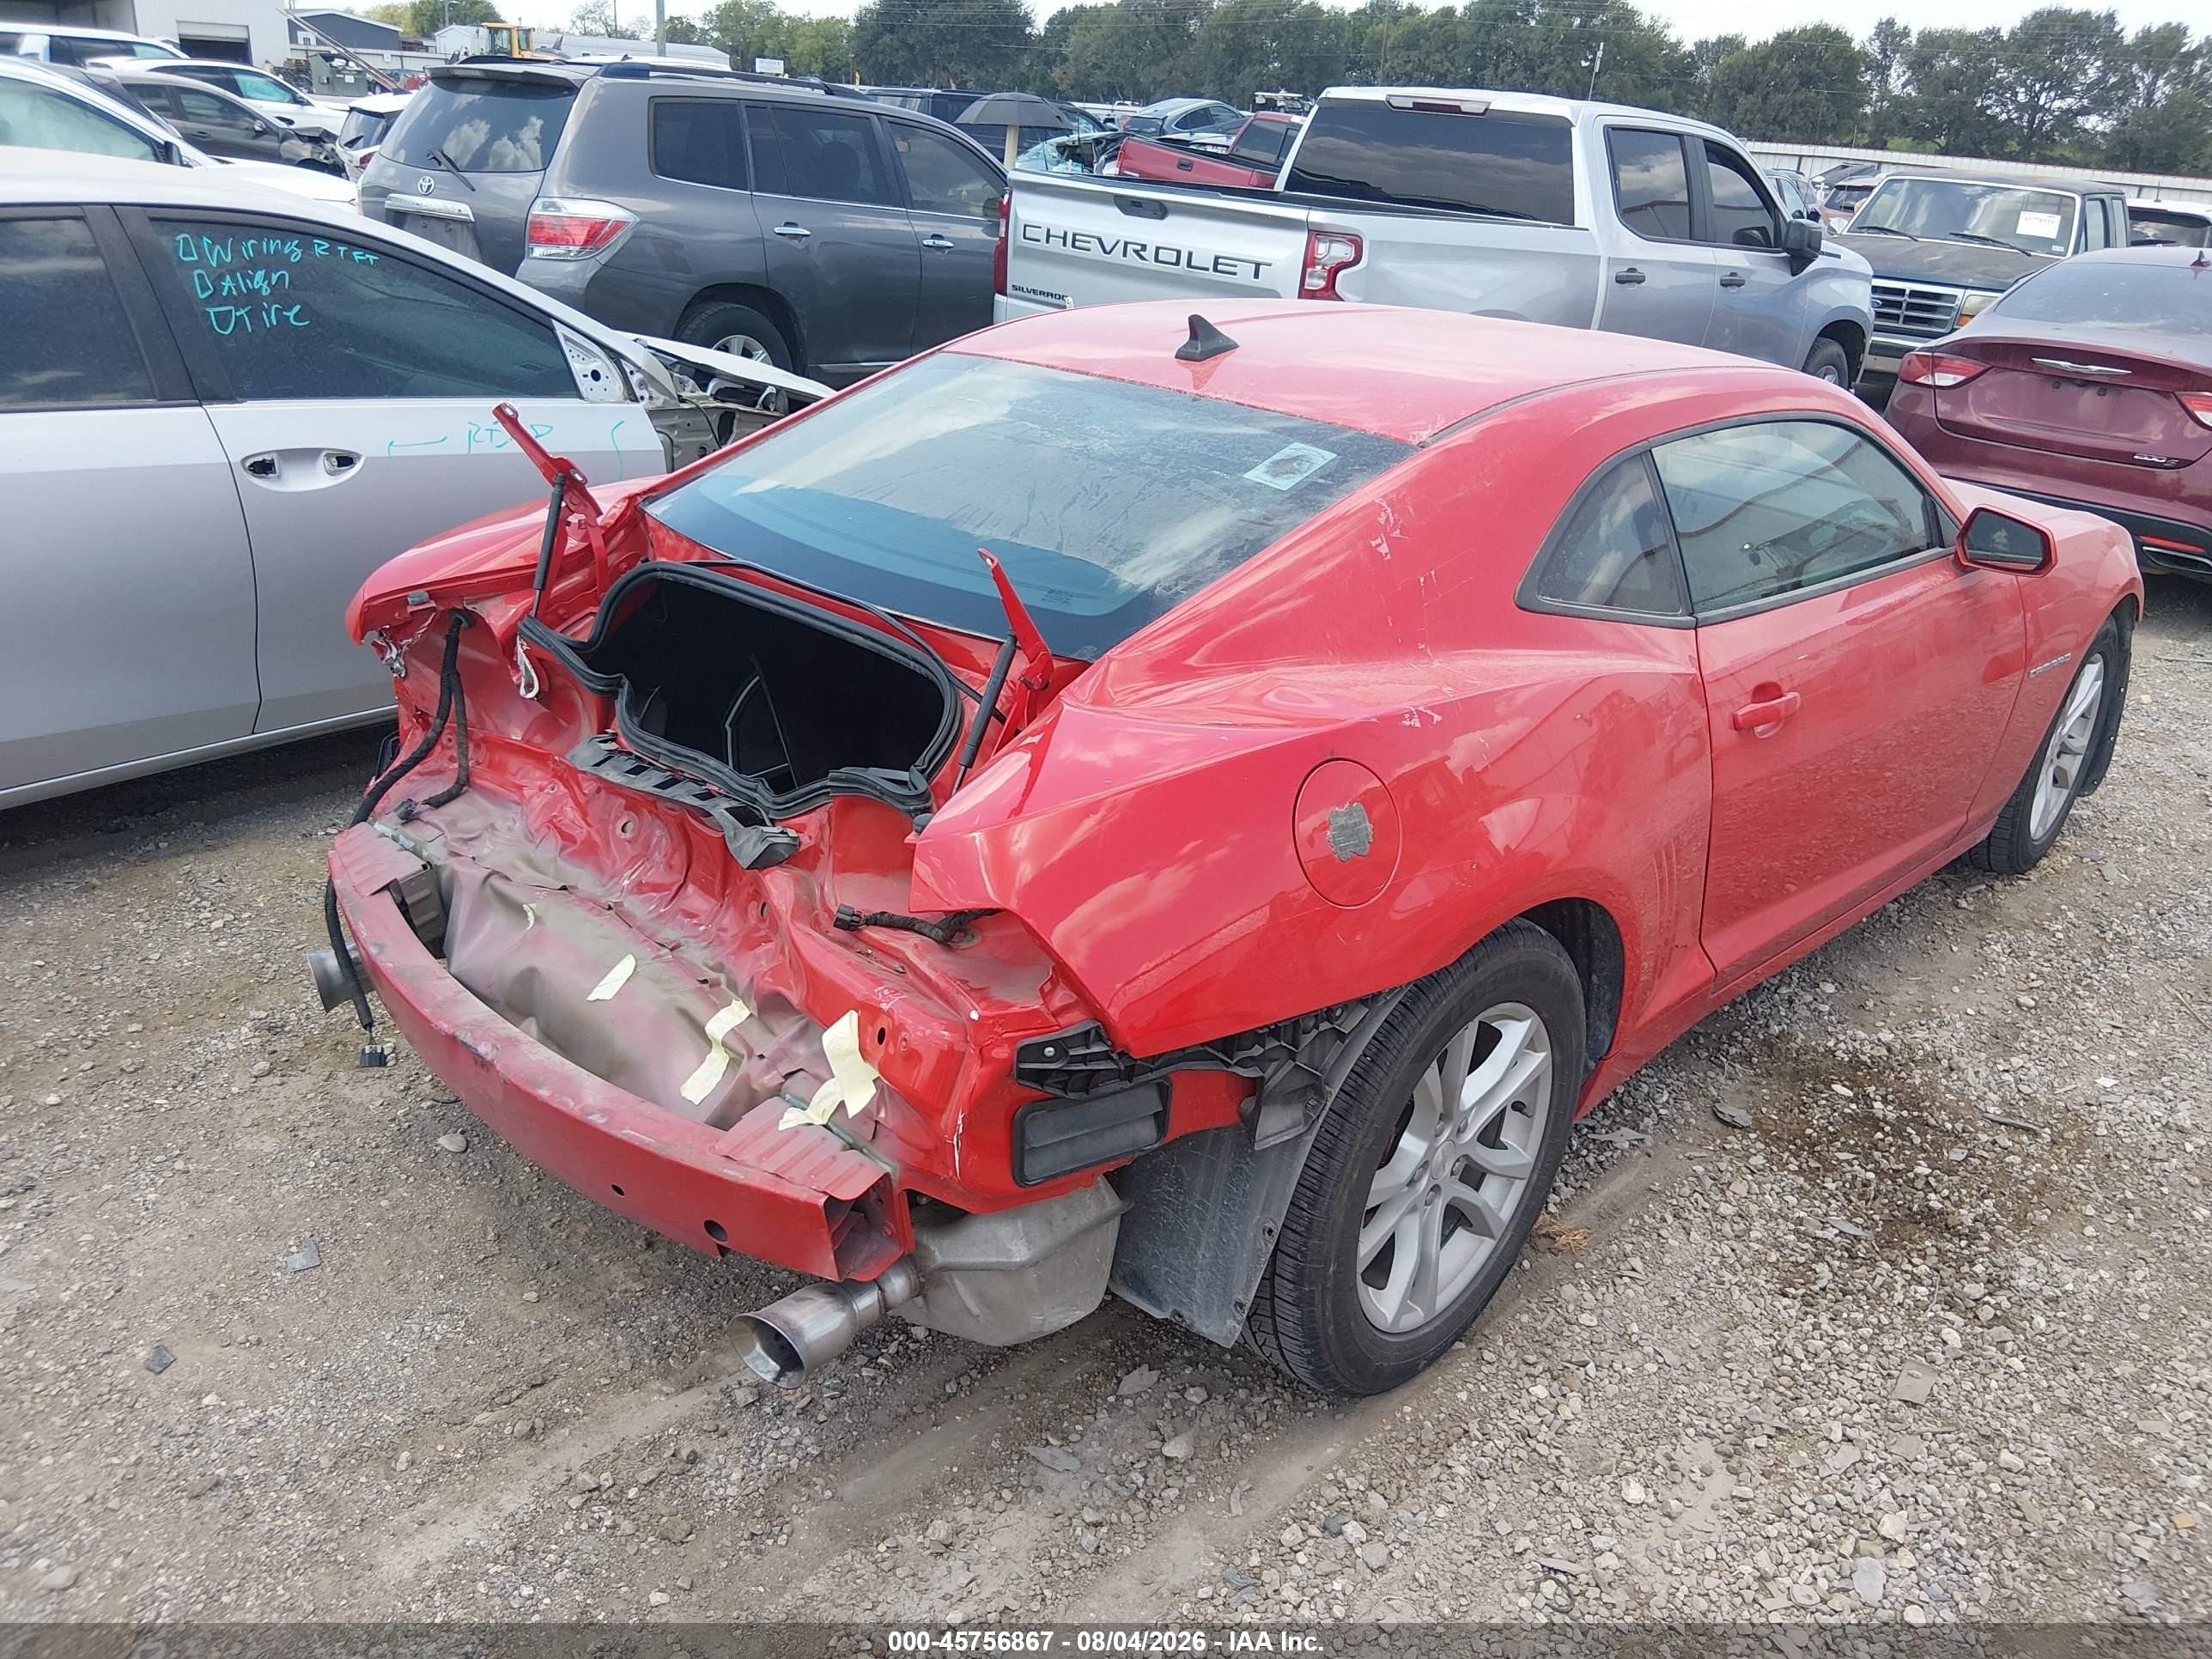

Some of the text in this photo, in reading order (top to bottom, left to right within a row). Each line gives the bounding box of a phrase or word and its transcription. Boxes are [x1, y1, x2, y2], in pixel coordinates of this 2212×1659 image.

[202, 235, 303, 268] Wiring
[1022, 223, 1273, 280] CHEVROLET
[220, 269, 289, 296] Align
